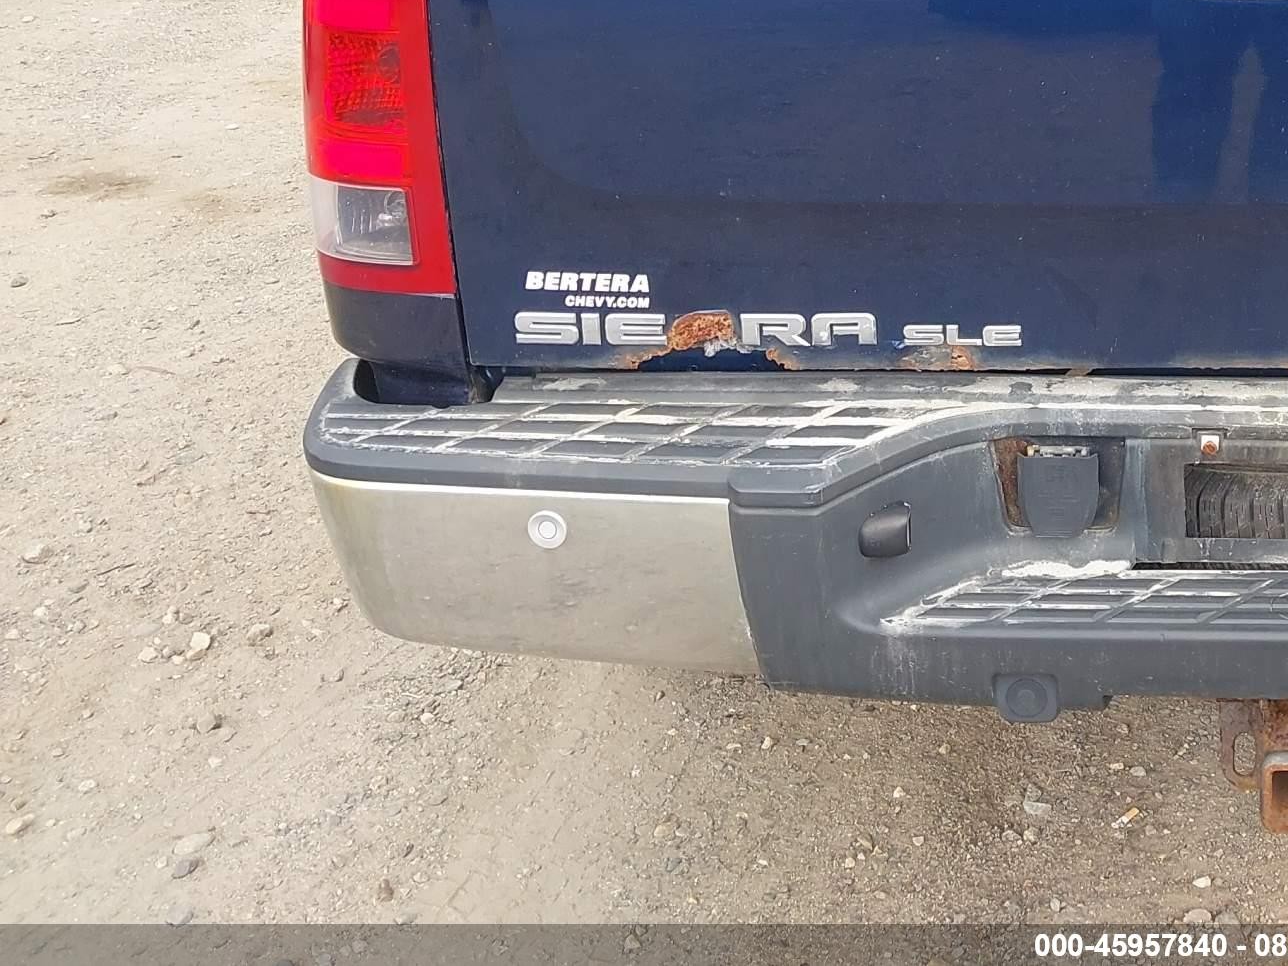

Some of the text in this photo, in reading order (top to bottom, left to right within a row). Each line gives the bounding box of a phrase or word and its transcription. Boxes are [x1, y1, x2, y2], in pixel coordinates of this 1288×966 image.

[525, 271, 650, 293] BERTERA
[564, 295, 650, 309] CHEVY.COM
[514, 311, 1023, 347] SIERA SLE
